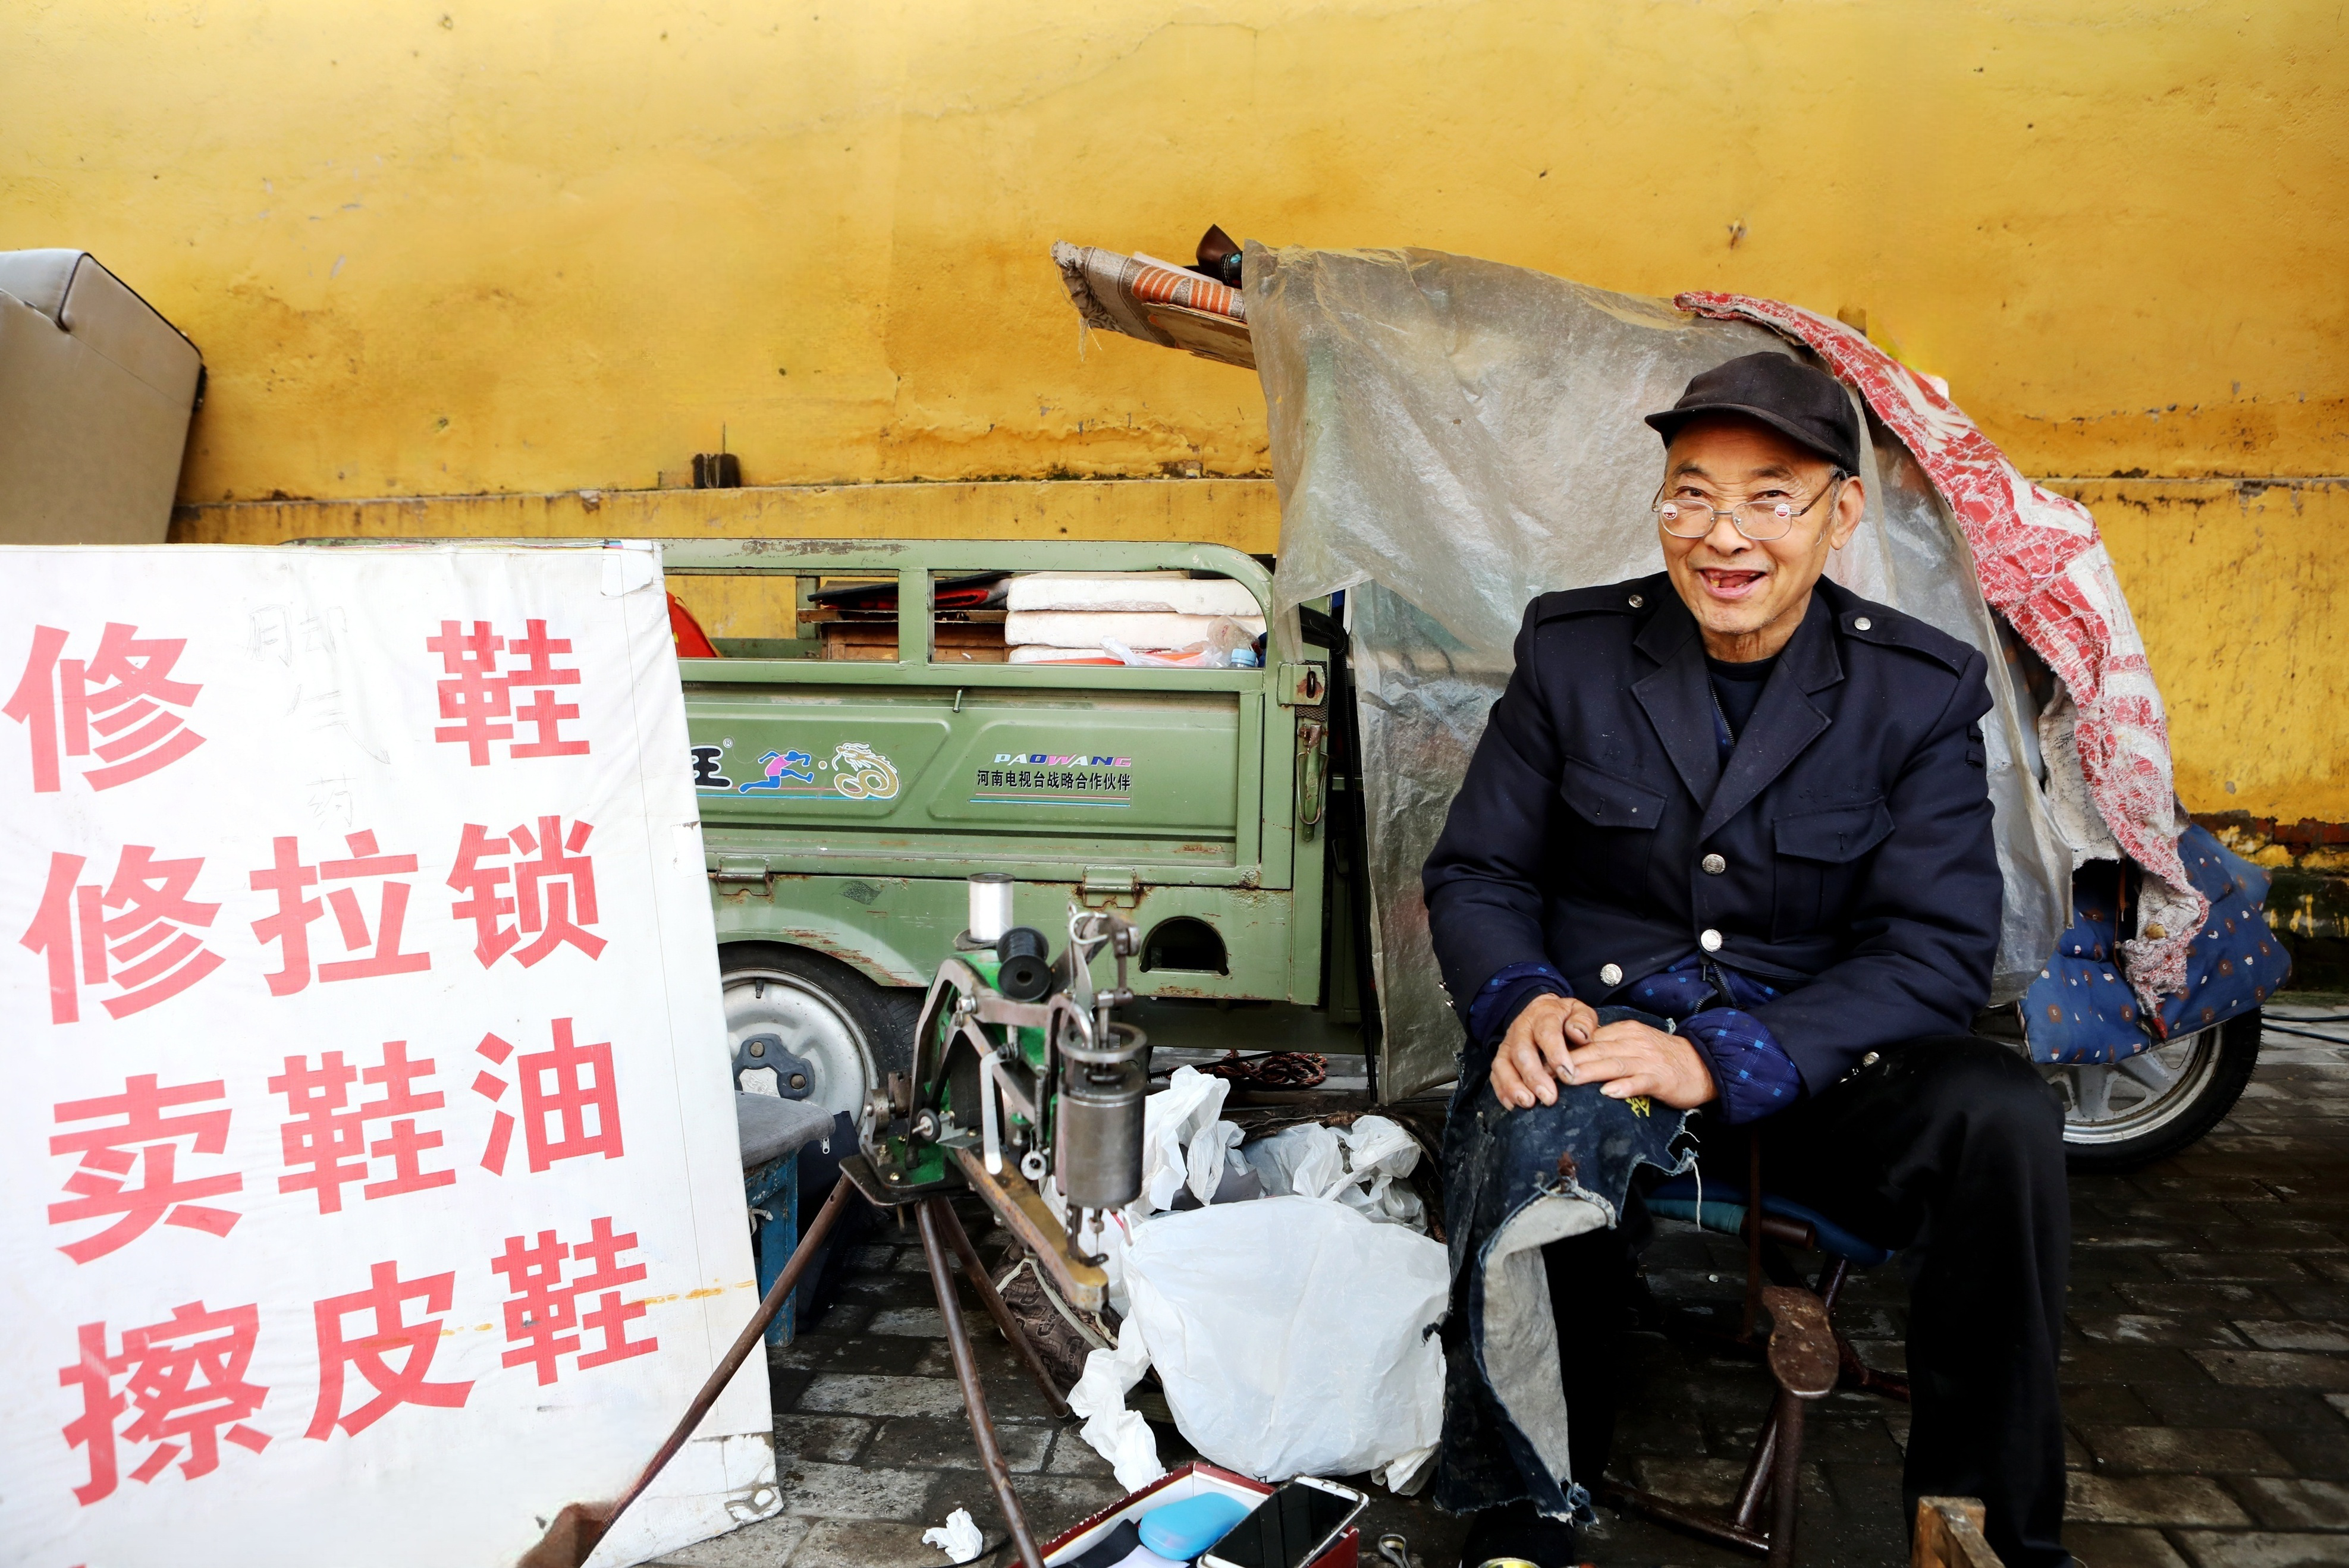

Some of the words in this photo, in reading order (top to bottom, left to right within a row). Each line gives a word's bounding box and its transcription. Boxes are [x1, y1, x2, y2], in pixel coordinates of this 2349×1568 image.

[977, 769, 1131, 791] 河南电视台战略合作伙伴
[994, 753, 1132, 768] PAOWANG
[20, 815, 608, 1025] 修拉锁
[48, 1017, 624, 1265] 卖鞋油
[59, 1216, 658, 1507] 擦皮鞋
